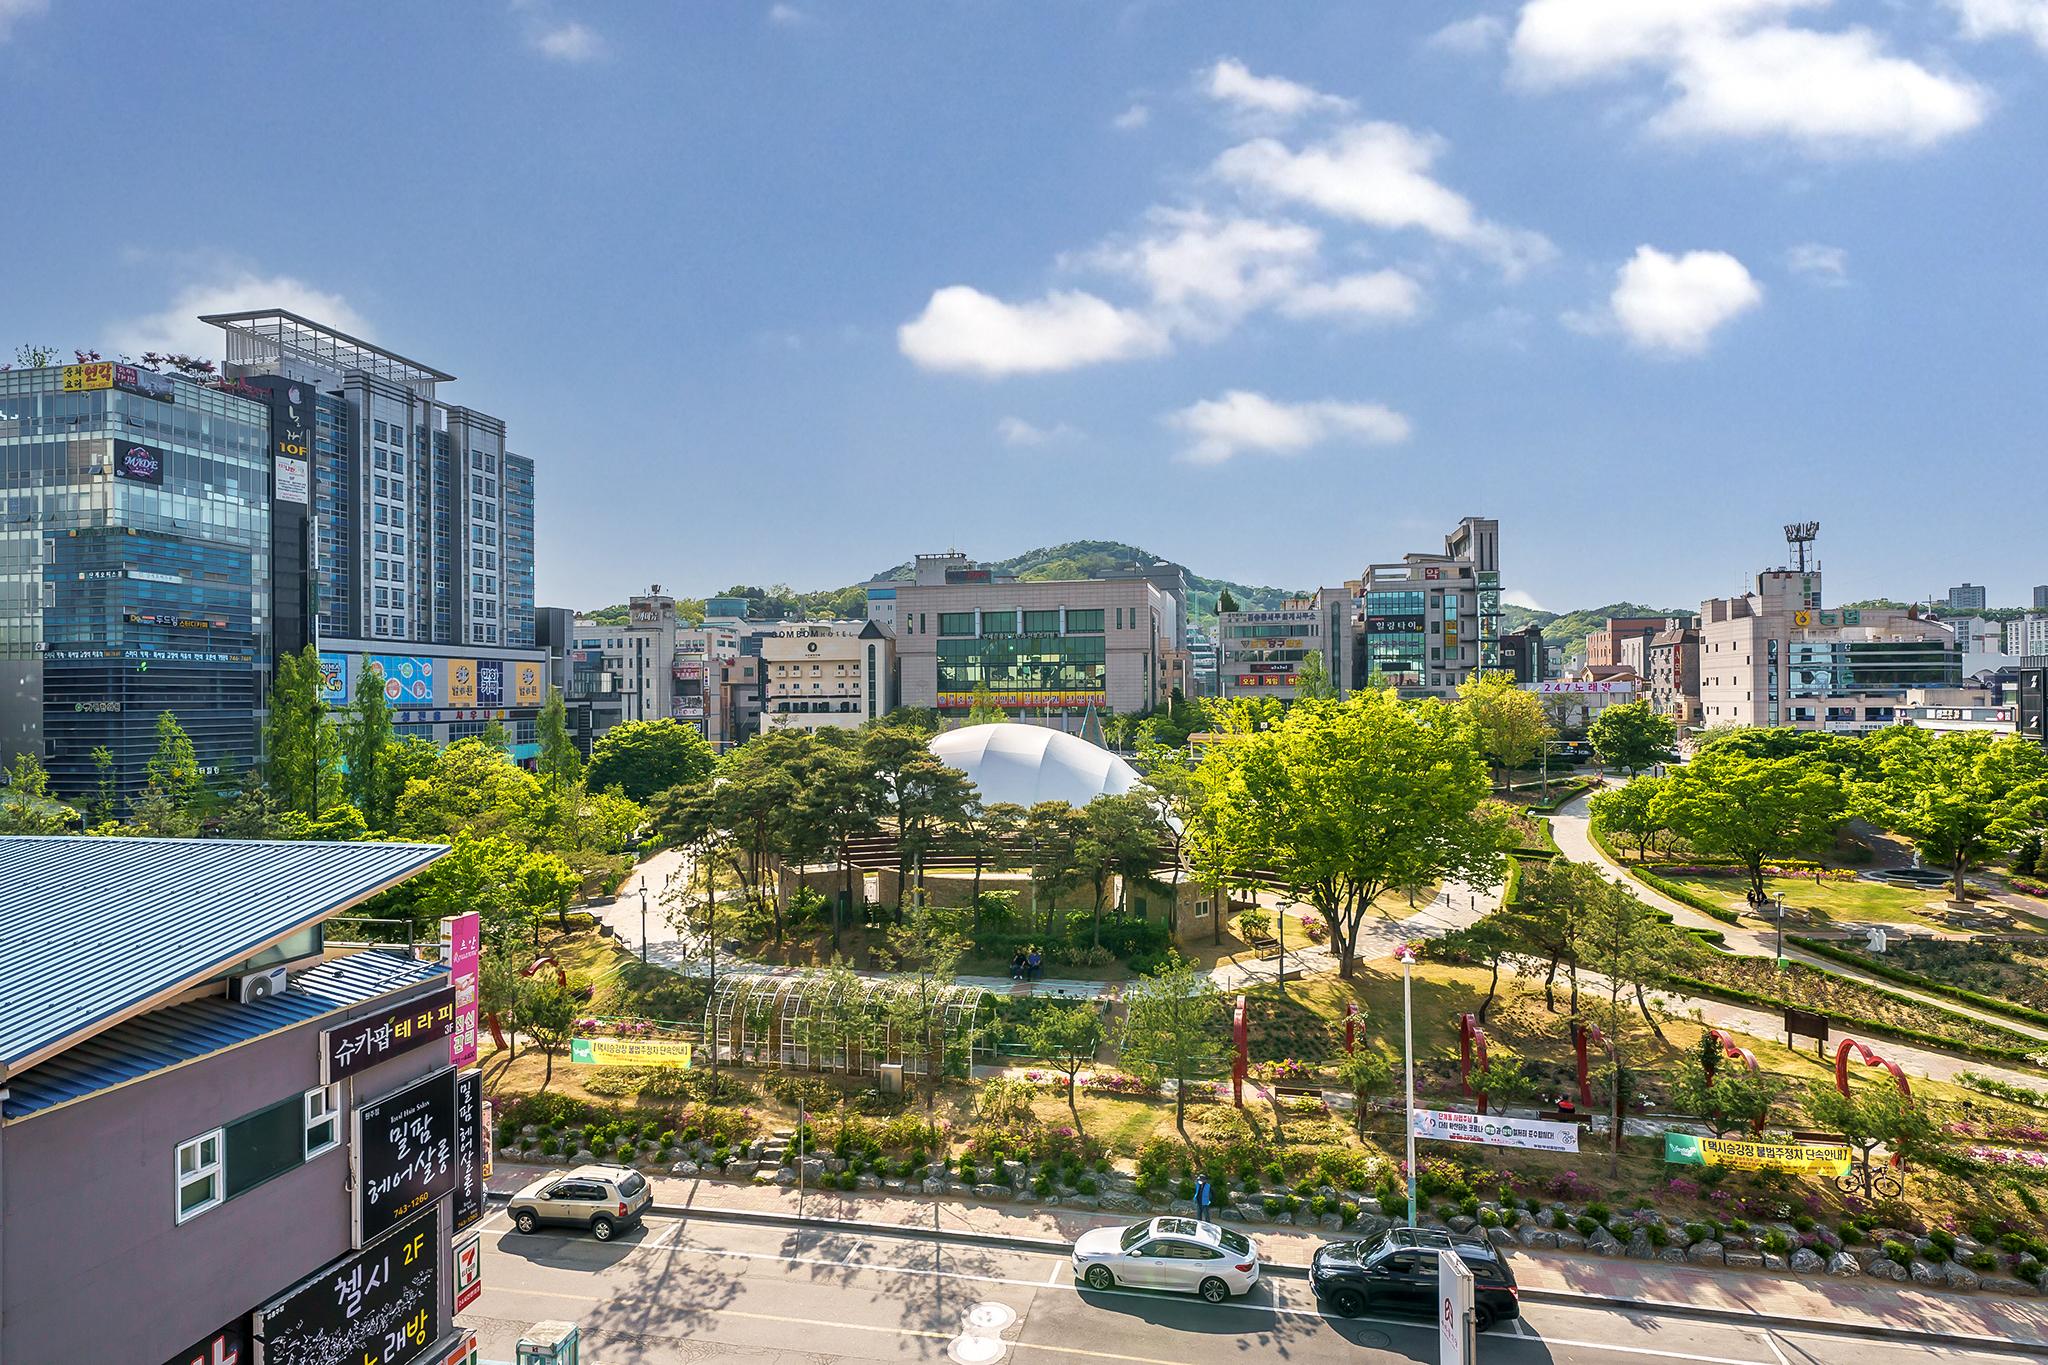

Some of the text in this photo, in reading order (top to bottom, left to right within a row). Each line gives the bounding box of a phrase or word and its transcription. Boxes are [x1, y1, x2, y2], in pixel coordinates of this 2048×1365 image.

[1820, 609, 1861, 625] 농협
[334, 1003, 453, 1068] 슈카팝 테라피
[444, 1022, 454, 1035] 3F
[389, 1113, 433, 1161] 밀팜
[458, 1081, 475, 1198] 밀팜 헤어살롱
[368, 1138, 450, 1205] 헤어살롱
[393, 1191, 429, 1219] 743-1260
[402, 1232, 425, 1266] 2F
[334, 1255, 390, 1319] 첼시
